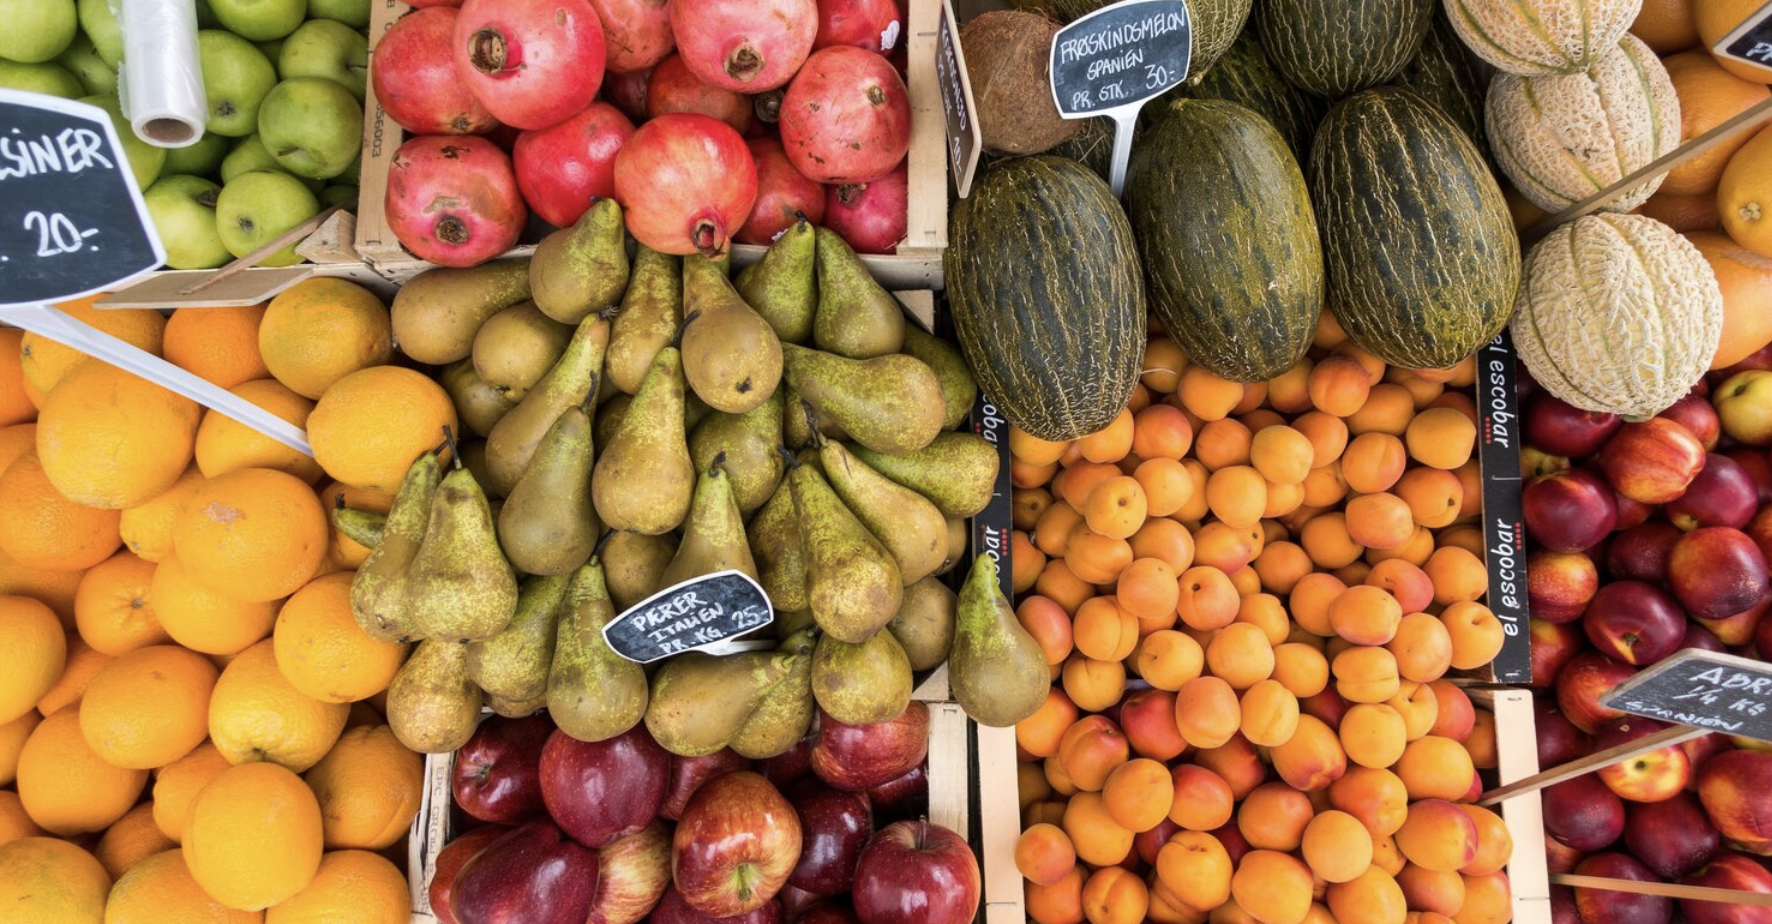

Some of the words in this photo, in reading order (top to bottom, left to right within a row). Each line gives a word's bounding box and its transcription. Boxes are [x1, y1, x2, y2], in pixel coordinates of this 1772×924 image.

[1059, 7, 1186, 64] FRØSKINDSMELON
[1087, 49, 1143, 81] SPANIEN
[1071, 90, 1096, 111] PR.
[0, 127, 114, 181] SINER
[1489, 334, 1508, 354] el
[1489, 360, 1515, 448] escobar
[1490, 518, 1520, 609] escobar
[630, 591, 708, 632] PÆRER
[647, 602, 724, 643] ITALIEN
[1498, 615, 1518, 636] el
[1688, 667, 1772, 696] ABR
